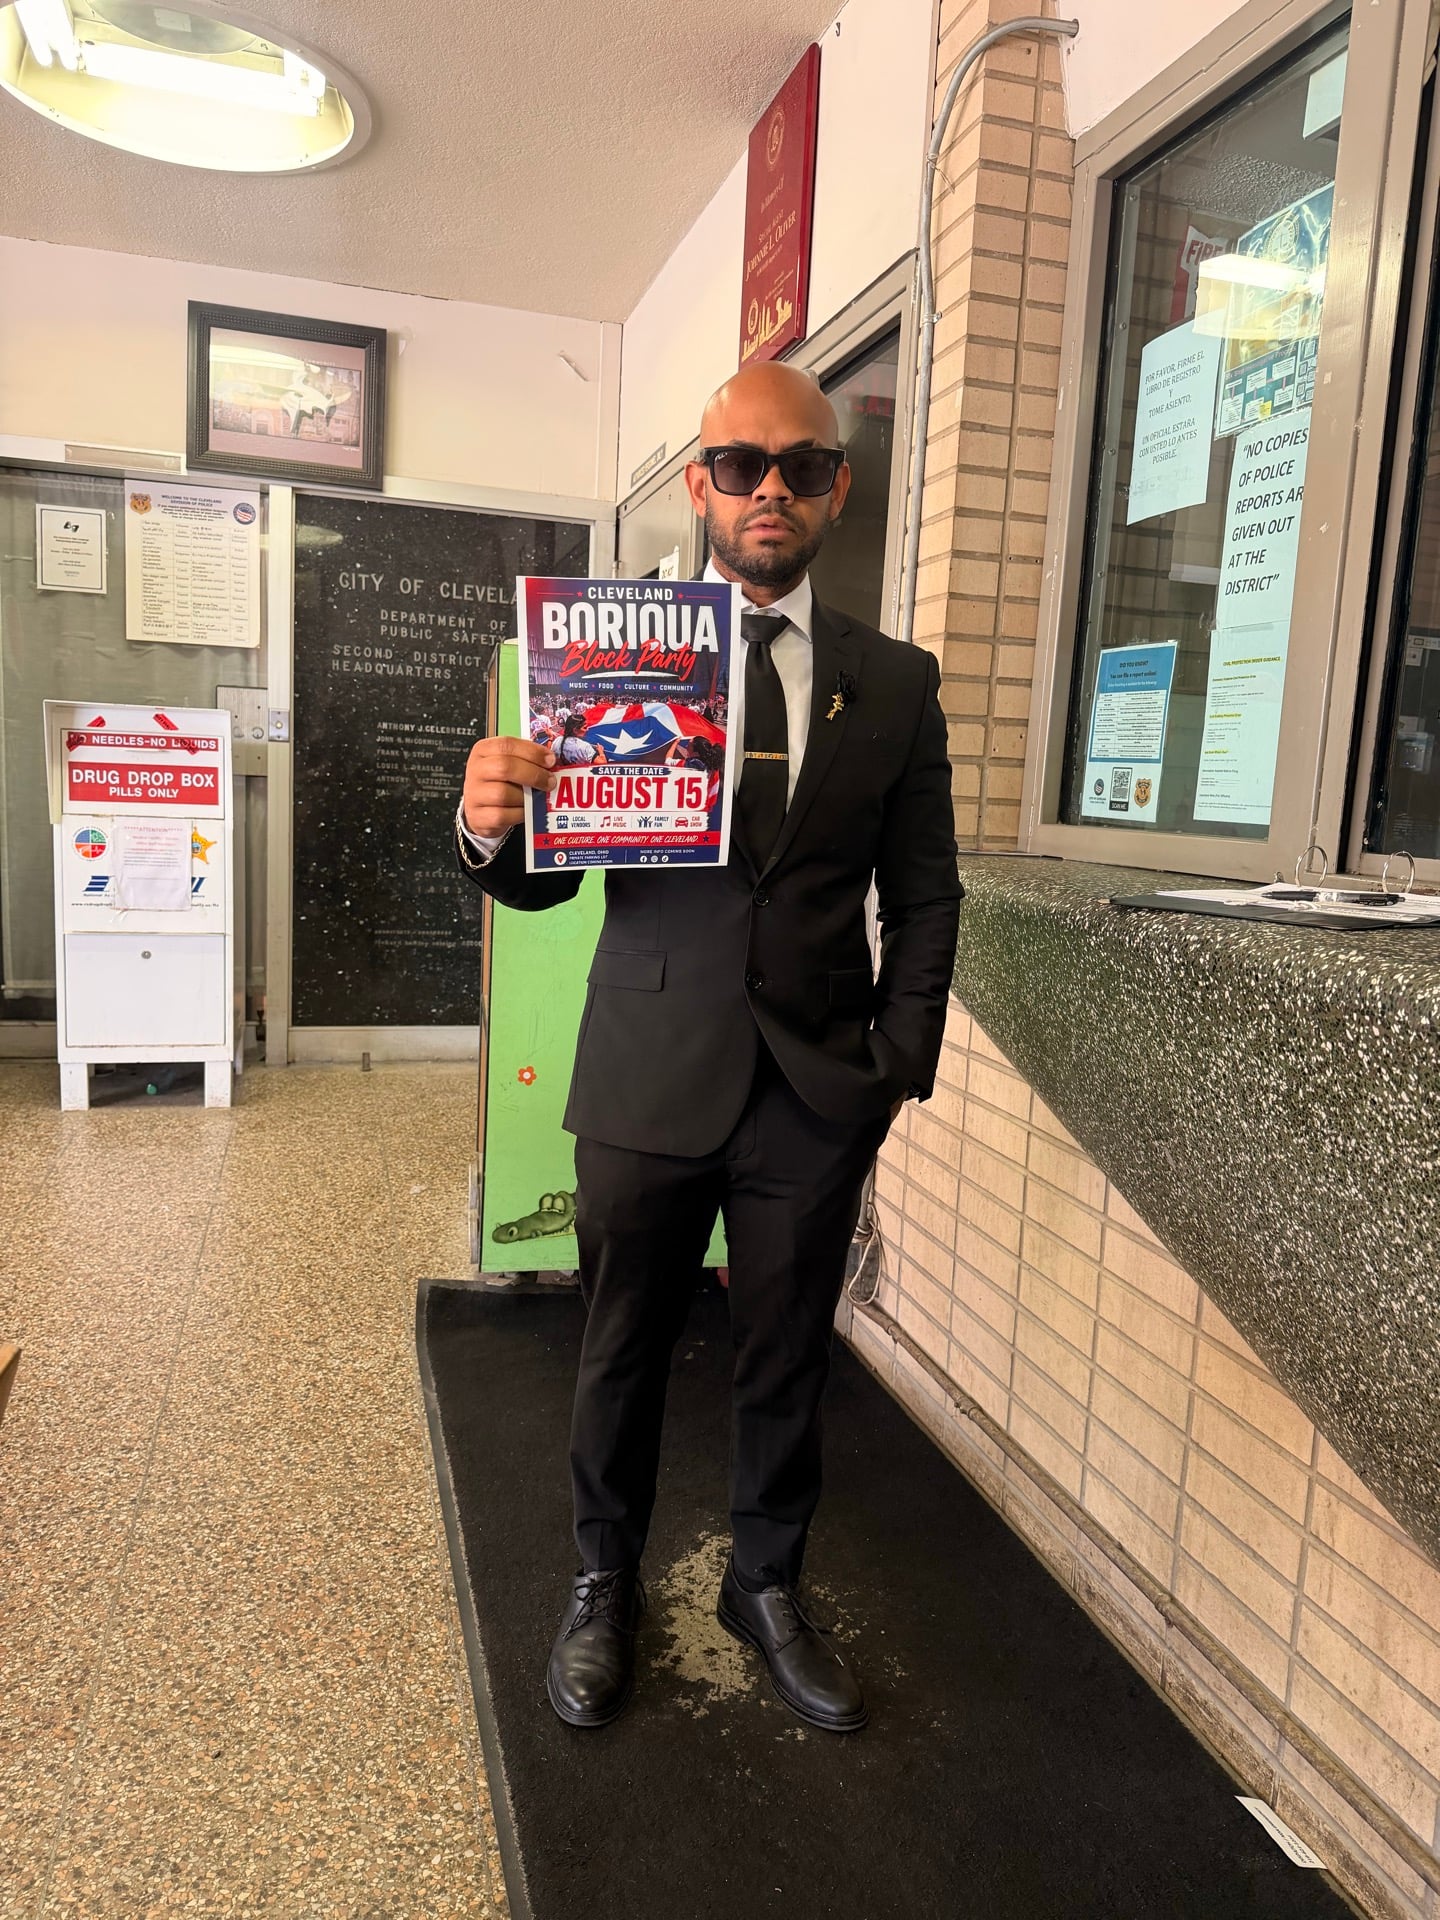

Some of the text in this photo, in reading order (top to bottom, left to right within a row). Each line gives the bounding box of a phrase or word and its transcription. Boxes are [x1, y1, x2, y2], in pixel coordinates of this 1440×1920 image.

[775, 210, 796, 243] OLIVER
[1145, 372, 1155, 385] POR
[1177, 353, 1197, 370] FIRME
[1197, 350, 1205, 361] EL
[1145, 364, 1201, 396] LIBRO DE REGISTRO
[1169, 388, 1174, 398] Y
[1149, 404, 1165, 418] TOME
[1150, 426, 1171, 441] OFICIAL
[1172, 417, 1195, 433] ESTARA
[1139, 428, 1197, 458] CON USTED LO ANTES
[1243, 427, 1309, 459] “NO COPIES
[1238, 459, 1295, 488] OF POLICE
[1234, 485, 1305, 516] REPORTS AR
[1232, 515, 1296, 542] GIVEN OUT
[1227, 548, 1267, 569] AT THE
[338, 571, 384, 592] CITY
[400, 577, 424, 596] OF
[587, 586, 674, 601] CLEVELAND
[1225, 573, 1280, 596] DISTRICT”
[380, 609, 508, 631] DEPARTMENT OF
[542, 601, 719, 653] BORIQUA
[380, 624, 507, 647] PUBLIC SAFETY
[332, 643, 482, 668] SECOND DISTRICT
[559, 637, 697, 682] Block Party
[331, 659, 452, 680] HEADQUARTERS
[624, 683, 650, 691] CULTURE
[659, 684, 694, 692] COMMUNITY
[376, 721, 416, 733] ANTHONY
[72, 769, 215, 788] DRUG DROP BOX
[598, 767, 664, 775] SAVE THE DATE
[108, 786, 180, 798] PILLS ONLY
[555, 776, 702, 809] AUGUST 15
[553, 836, 567, 845] ONE
[596, 835, 611, 844] ONE
[650, 835, 664, 843] ONE
